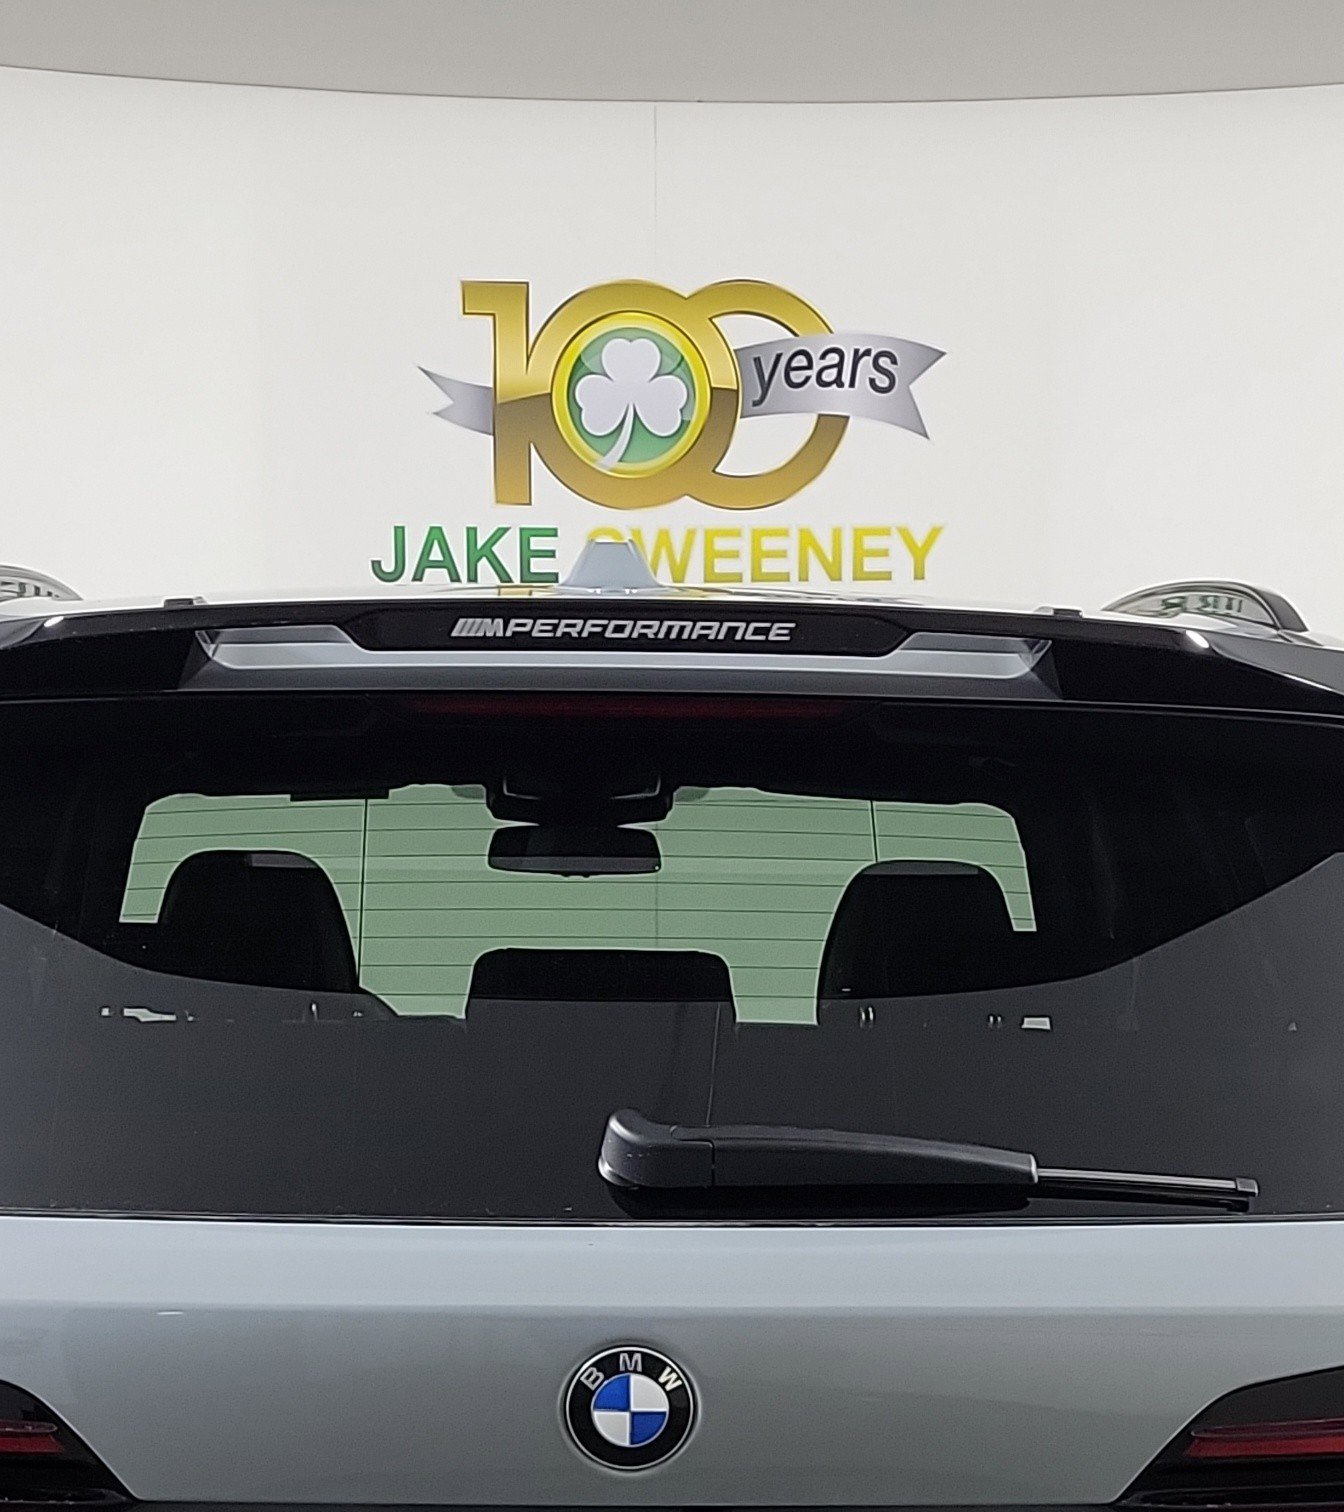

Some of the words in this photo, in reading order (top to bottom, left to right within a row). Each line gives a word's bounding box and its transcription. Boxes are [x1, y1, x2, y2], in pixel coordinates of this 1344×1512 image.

[460, 279, 850, 510] 100
[752, 342, 900, 406] years
[370, 526, 560, 583] JAKE
[586, 526, 945, 583] WEENEY
[580, 1352, 683, 1392] BMW
